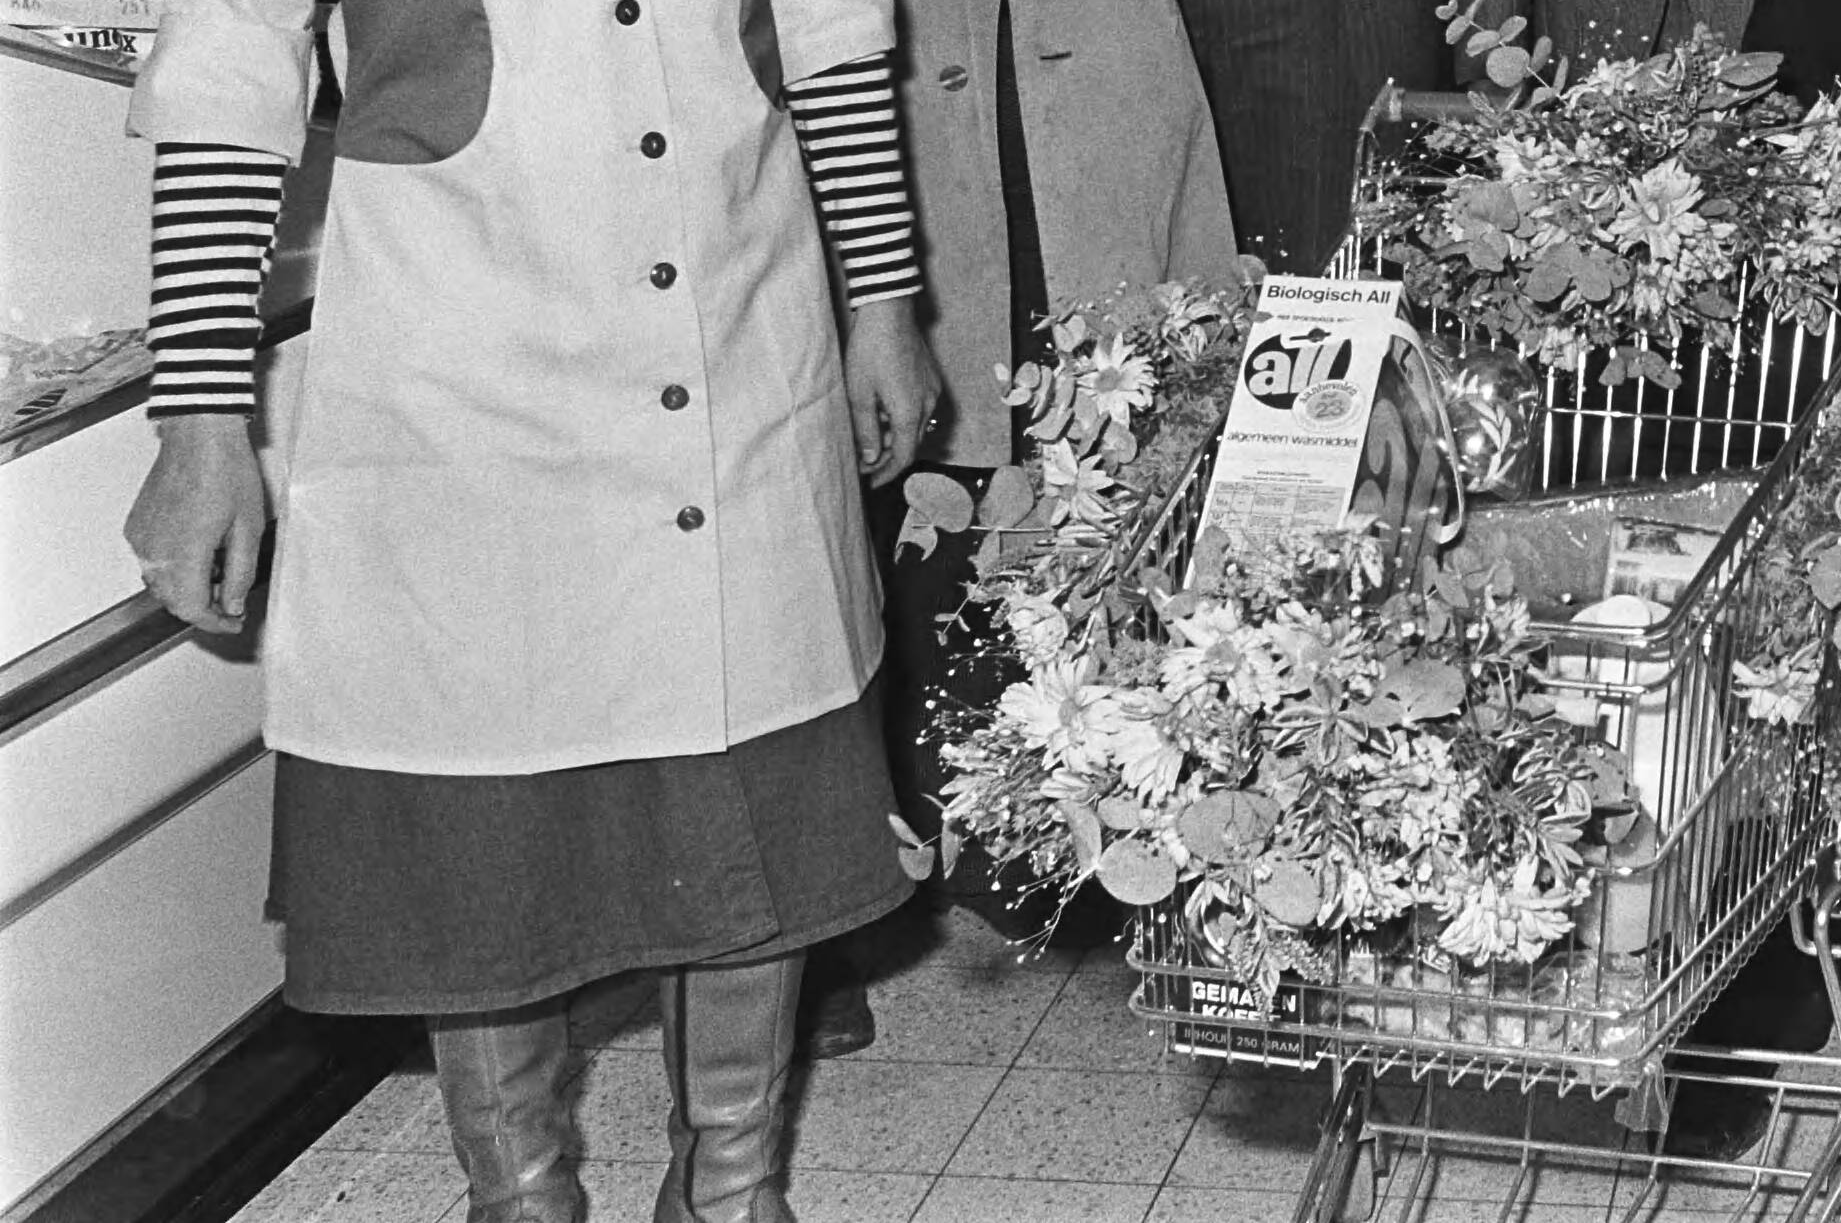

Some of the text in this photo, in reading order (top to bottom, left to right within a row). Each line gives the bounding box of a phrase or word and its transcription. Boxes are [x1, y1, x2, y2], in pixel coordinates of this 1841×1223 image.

[1266, 284, 1391, 304] Biologisch All
[1249, 339, 1346, 396] all
[1226, 431, 1359, 448] algemeen wasmiddel
[1236, 1036, 1258, 1048] 250
